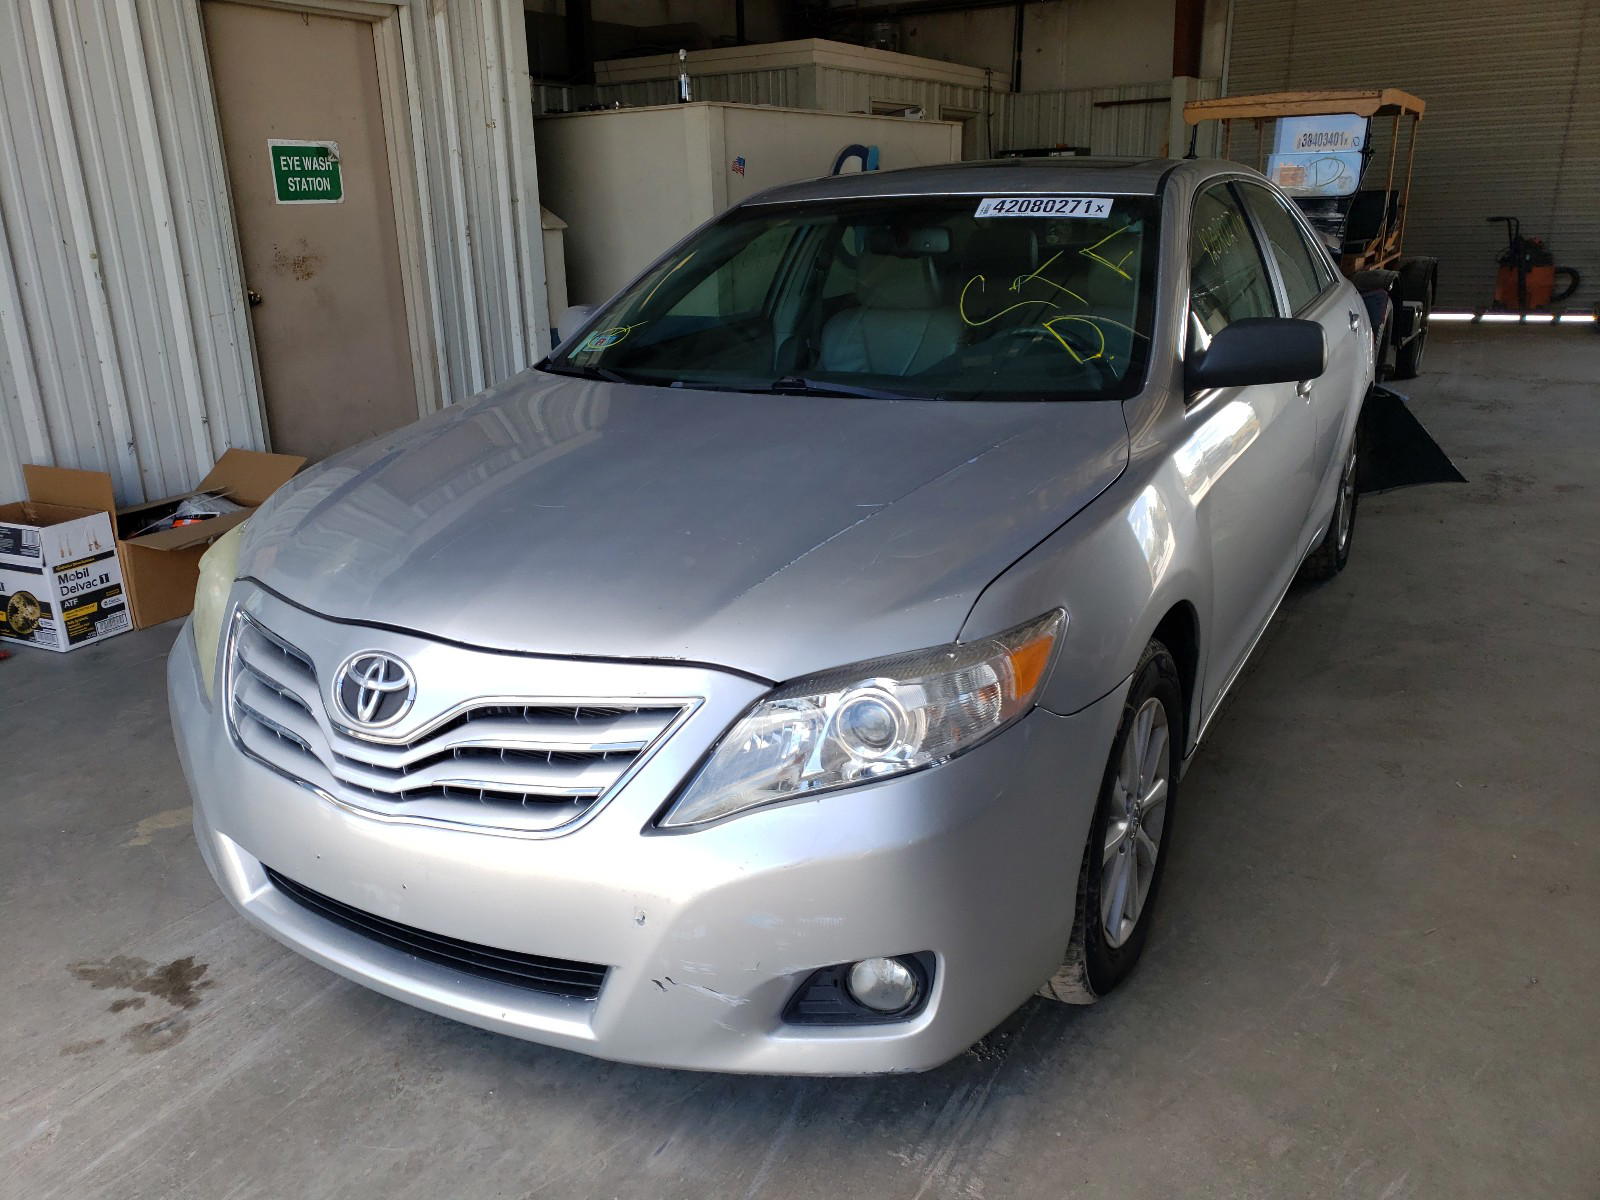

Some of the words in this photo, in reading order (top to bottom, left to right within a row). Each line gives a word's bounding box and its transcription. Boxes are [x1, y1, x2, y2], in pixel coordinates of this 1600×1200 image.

[1301, 132, 1344, 148] 38403401
[280, 157, 301, 170] EYE
[302, 157, 332, 170] WASH
[288, 177, 330, 191] STATION
[992, 199, 1093, 214] 42080271
[57, 567, 90, 585] Mobil
[60, 578, 98, 597] Delvac
[64, 598, 79, 609] ATF
